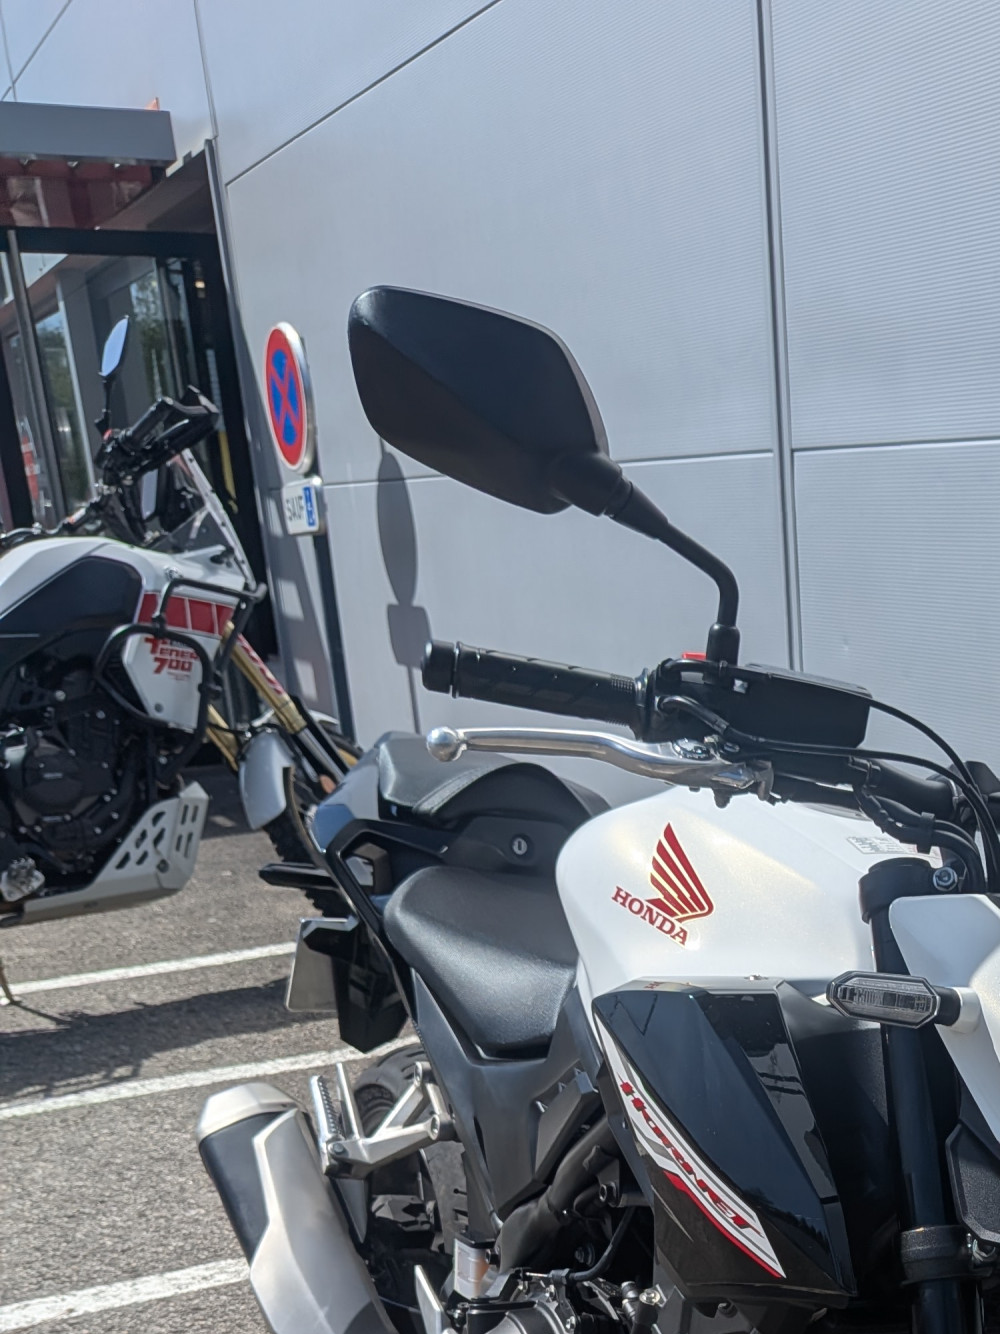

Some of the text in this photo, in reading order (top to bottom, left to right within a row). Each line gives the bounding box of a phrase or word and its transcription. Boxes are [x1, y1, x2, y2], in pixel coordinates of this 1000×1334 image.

[153, 657, 193, 675] 700
[611, 885, 689, 946] HONDA
[617, 1071, 765, 1239] HORNET
